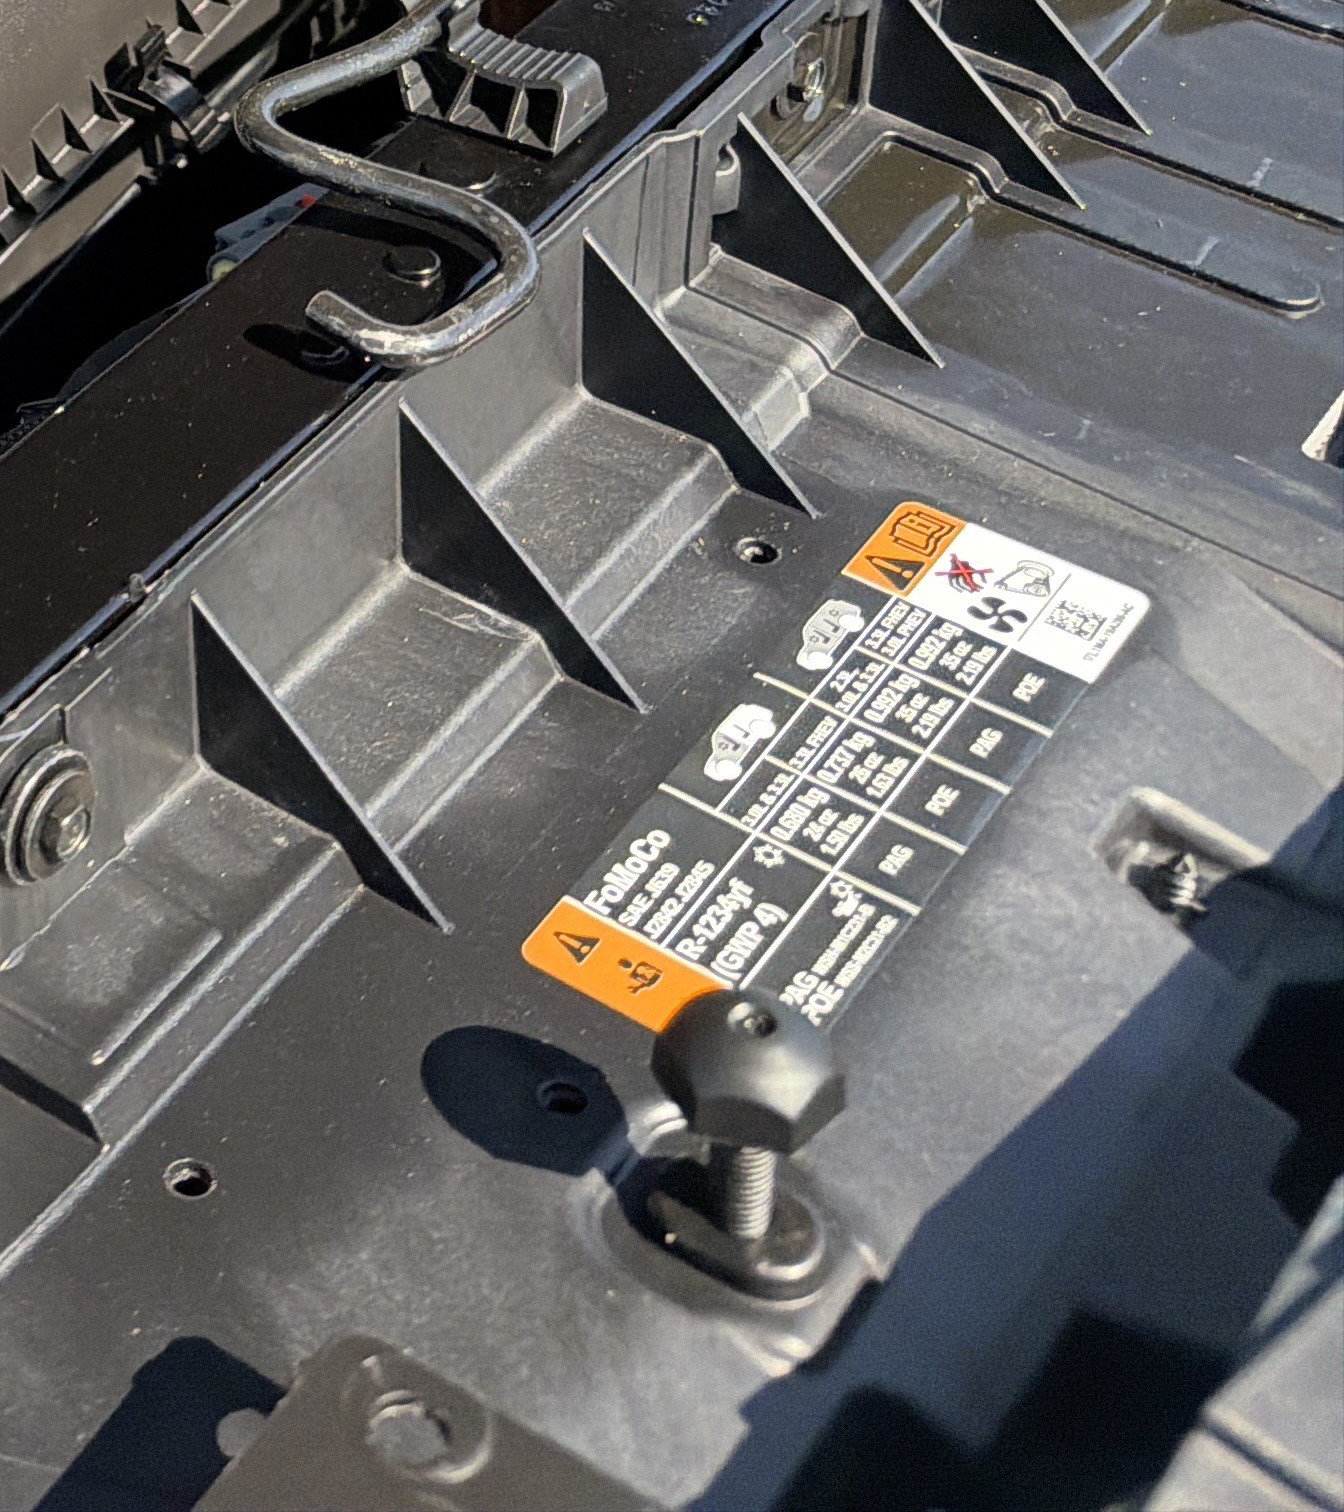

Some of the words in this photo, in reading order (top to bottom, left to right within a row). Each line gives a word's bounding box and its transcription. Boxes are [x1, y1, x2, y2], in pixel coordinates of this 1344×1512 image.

[907, 635, 947, 670] 0.992
[930, 621, 964, 641] kg
[938, 651, 961, 670] 35
[952, 640, 972, 657] oz
[955, 659, 984, 685] 2.19
[970, 645, 997, 664] lbs
[863, 687, 903, 723] 0.992
[887, 672, 920, 693] kg
[894, 703, 918, 722] 35
[909, 692, 929, 709] oz
[1012, 672, 1045, 702] POE
[911, 712, 941, 739] 2.19
[927, 696, 954, 717] lbs
[816, 745, 855, 783] 0.737
[841, 730, 876, 752] kg
[969, 727, 1002, 758] PAG
[848, 764, 872, 784] 26
[863, 751, 884, 769] oz
[865, 772, 895, 798] 1.63
[881, 756, 909, 777] lbs
[769, 802, 811, 841] 0.680
[795, 786, 830, 808] kg
[924, 784, 959, 816] POE
[802, 820, 827, 842] 24
[817, 808, 839, 826] oz
[819, 829, 850, 855] 1.50
[836, 813, 864, 835] lbs
[583, 829, 671, 915] FoMoCo
[878, 844, 913, 875] PAG
[618, 892, 654, 926] SAE
[644, 862, 679, 898] J639
[675, 876, 754, 961] R-1234yf
[710, 920, 764, 980] (GWP
[753, 902, 789, 927] 4)
